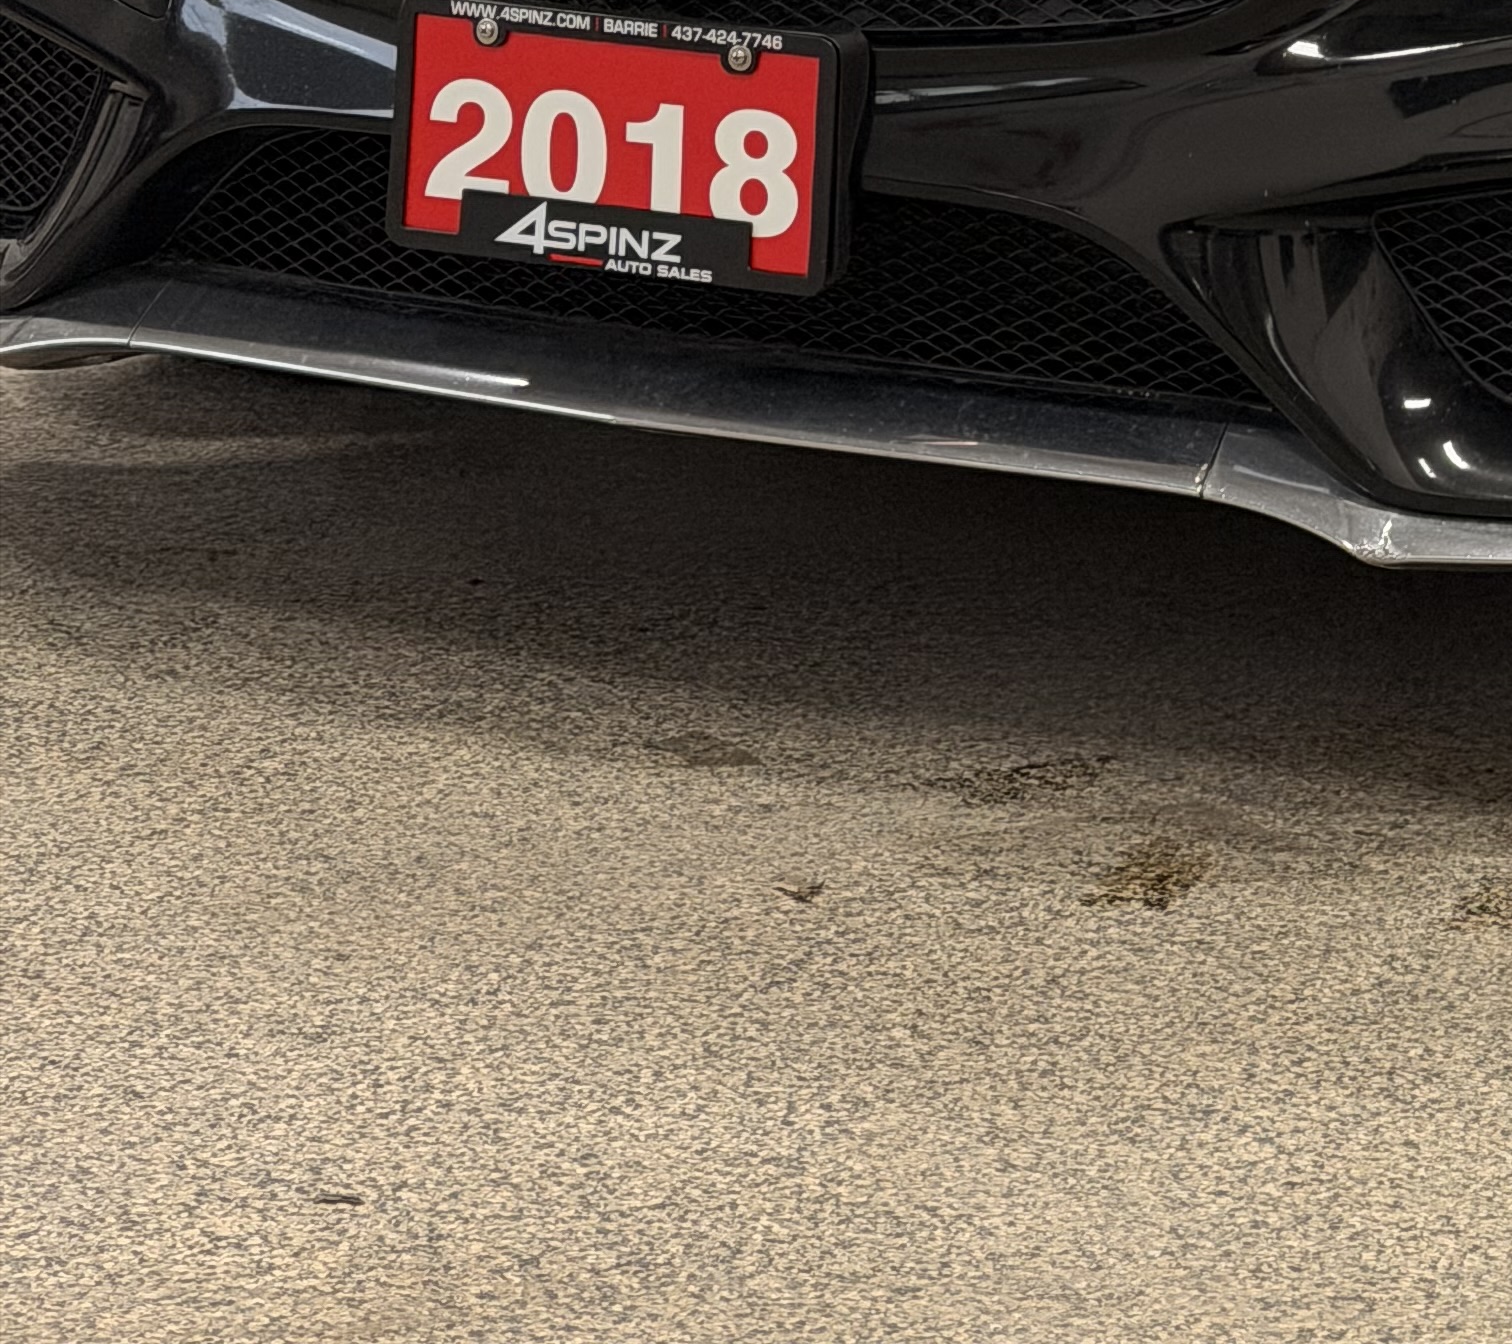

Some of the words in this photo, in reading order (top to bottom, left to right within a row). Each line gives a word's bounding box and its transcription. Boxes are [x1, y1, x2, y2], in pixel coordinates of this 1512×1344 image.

[450, 0, 591, 31] WWW.4SPINZ.COM
[603, 17, 659, 38] BARRIE
[670, 25, 783, 50] 437-424-7746
[424, 78, 800, 239] 2018
[493, 201, 683, 264] 4SPINZ
[604, 258, 652, 276] AUTO
[656, 264, 713, 283] SALES
